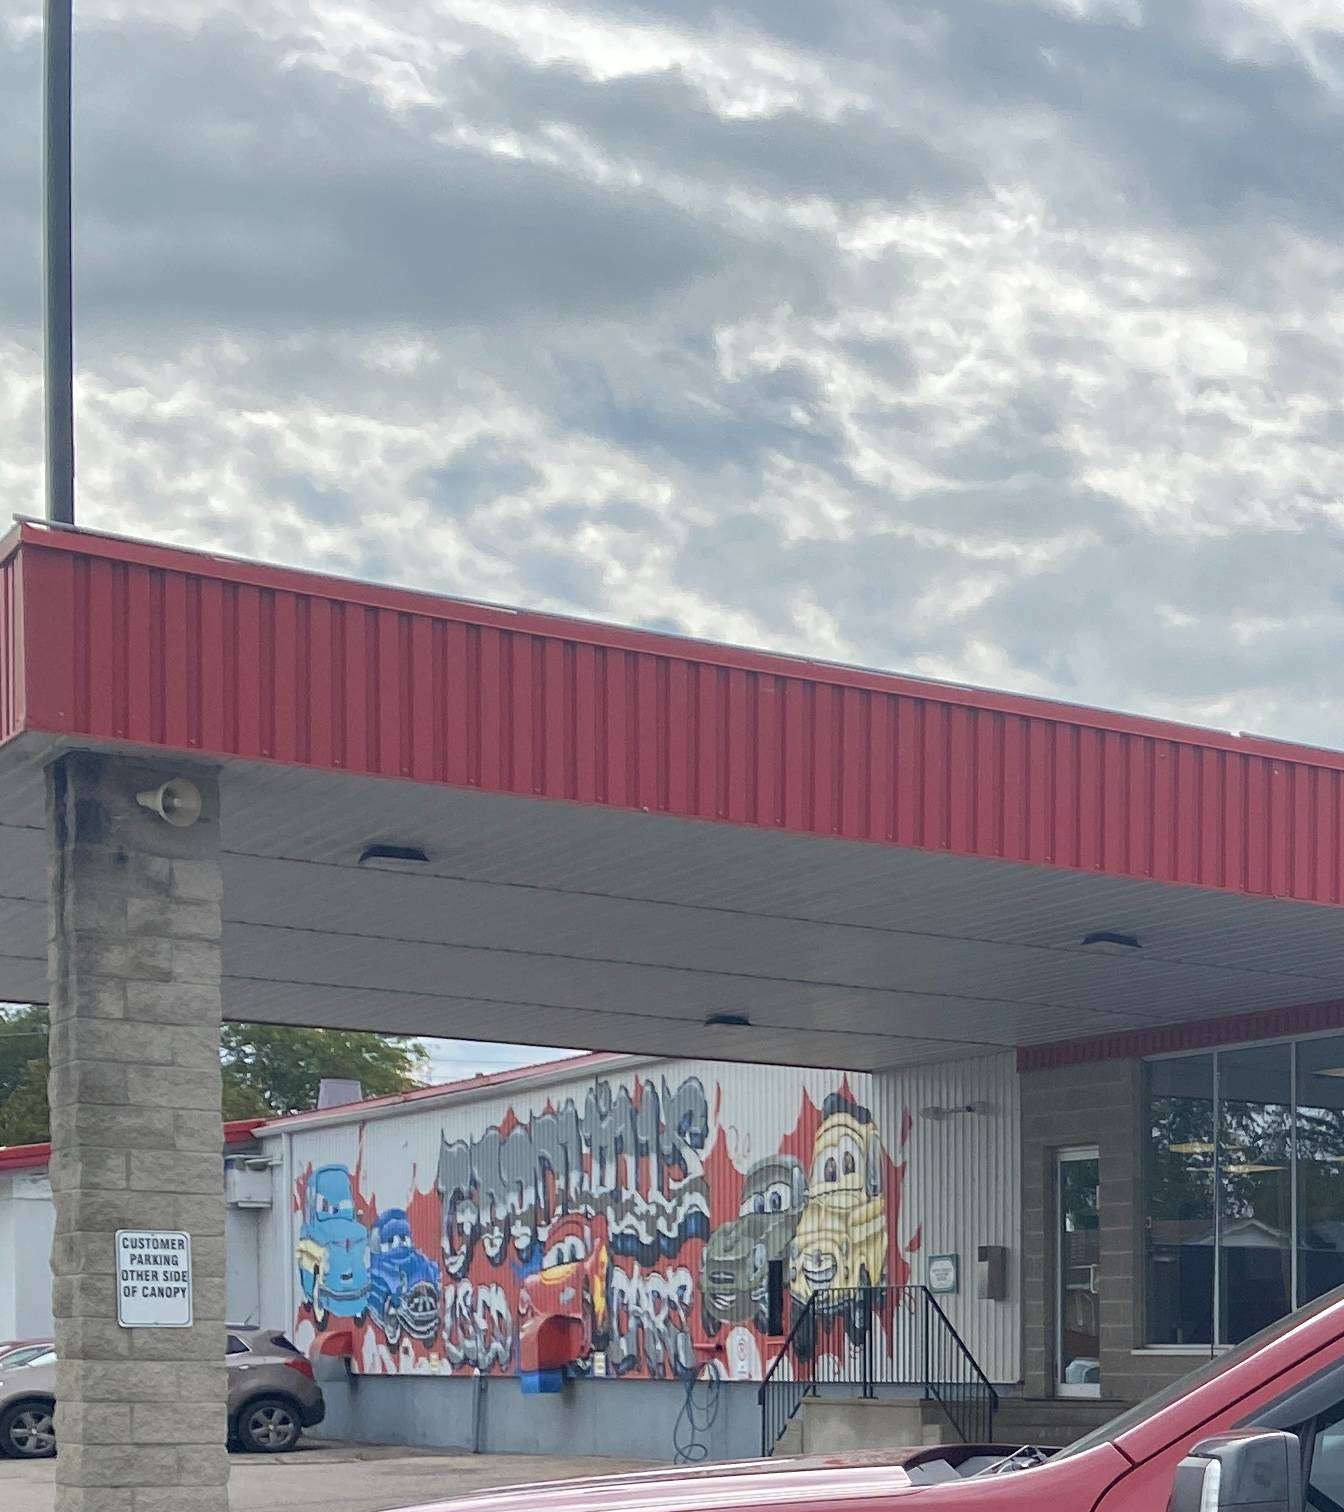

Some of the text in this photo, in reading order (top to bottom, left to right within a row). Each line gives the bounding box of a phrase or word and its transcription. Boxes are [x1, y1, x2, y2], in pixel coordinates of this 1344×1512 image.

[122, 1237, 185, 1250] CUSTOMER
[129, 1253, 179, 1266] PARKING
[121, 1269, 189, 1283] OTHER SIDE
[123, 1285, 187, 1298] OF CANOPY
